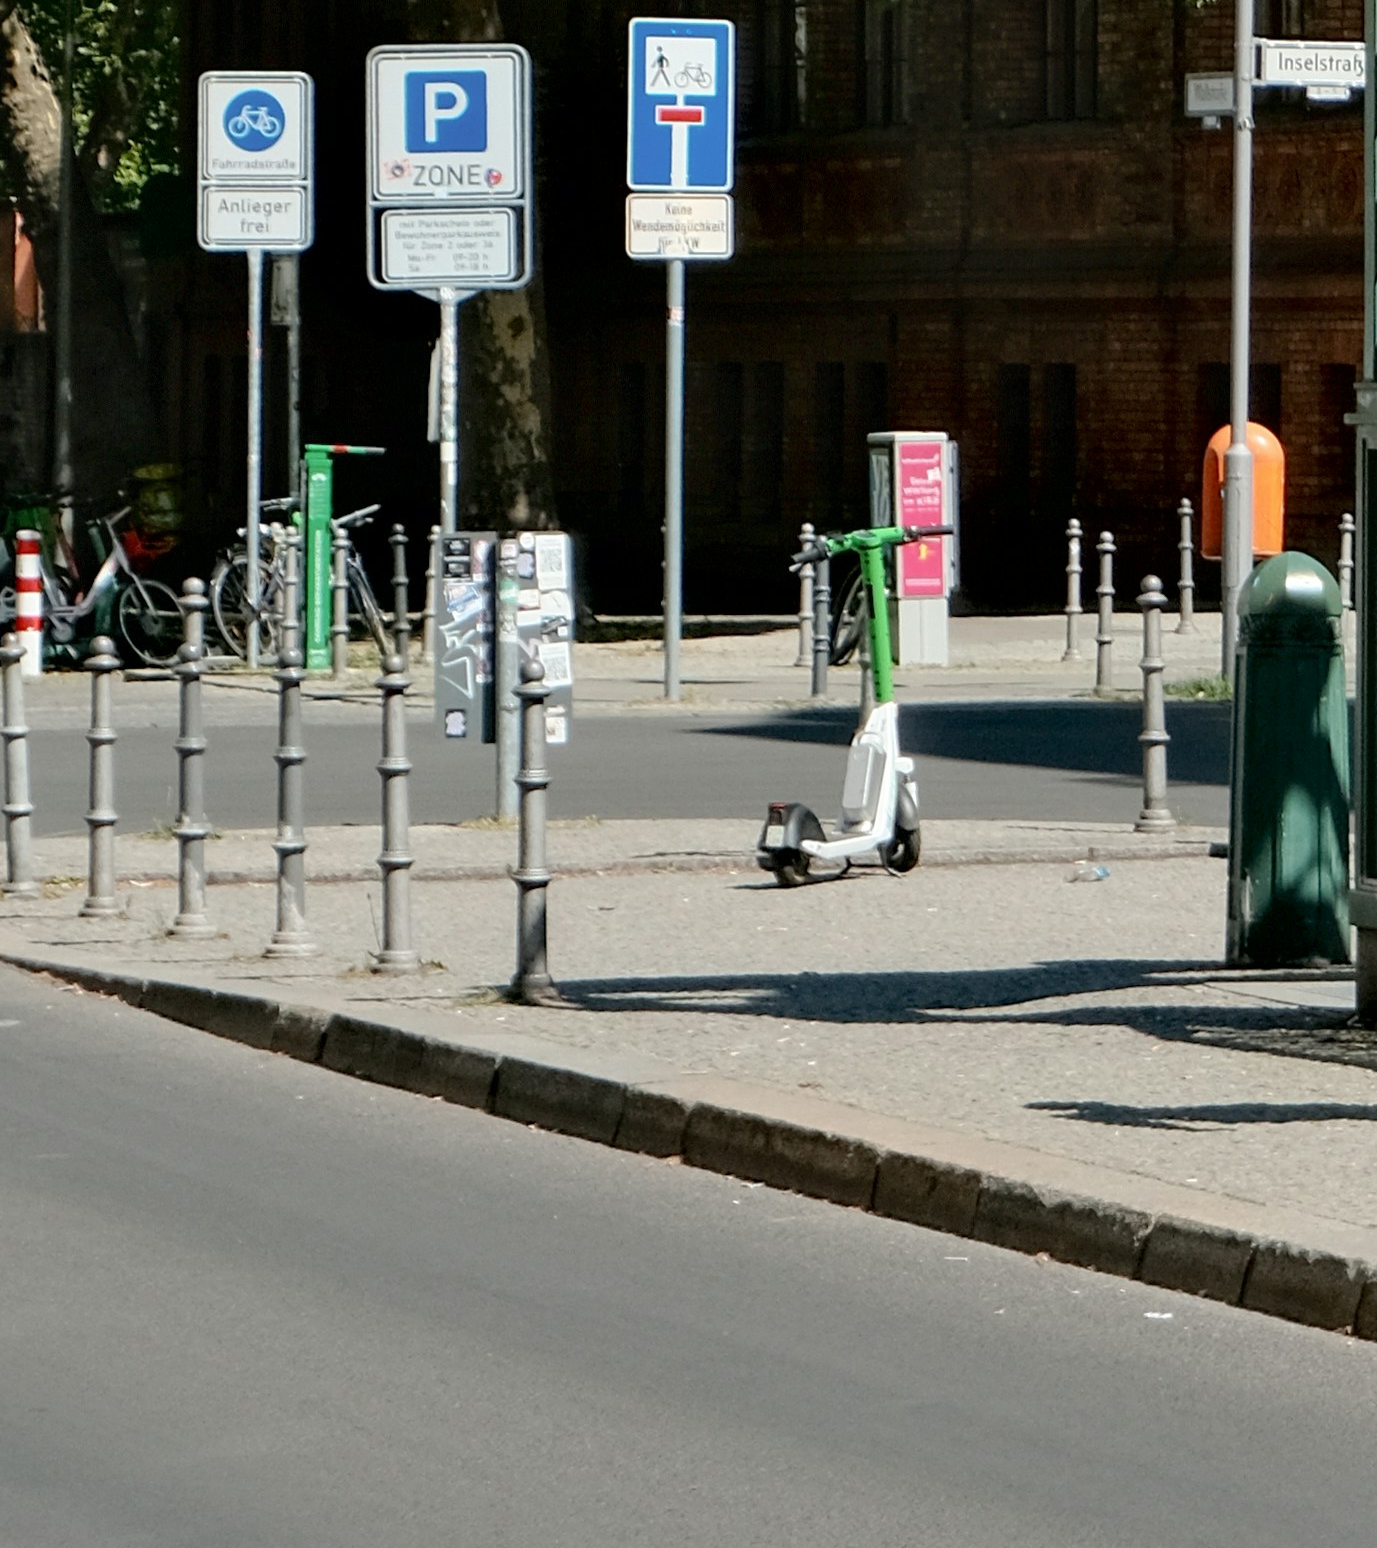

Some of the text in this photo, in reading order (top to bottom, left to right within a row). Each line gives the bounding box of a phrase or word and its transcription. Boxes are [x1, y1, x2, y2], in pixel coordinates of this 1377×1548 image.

[1278, 52, 1365, 76] Inselstraß
[423, 81, 469, 143] P
[212, 158, 296, 170] Fahrradstraße
[411, 164, 483, 187] ZONE
[217, 198, 292, 217] Anlieger
[665, 203, 692, 215] Keine
[240, 216, 270, 233] frei
